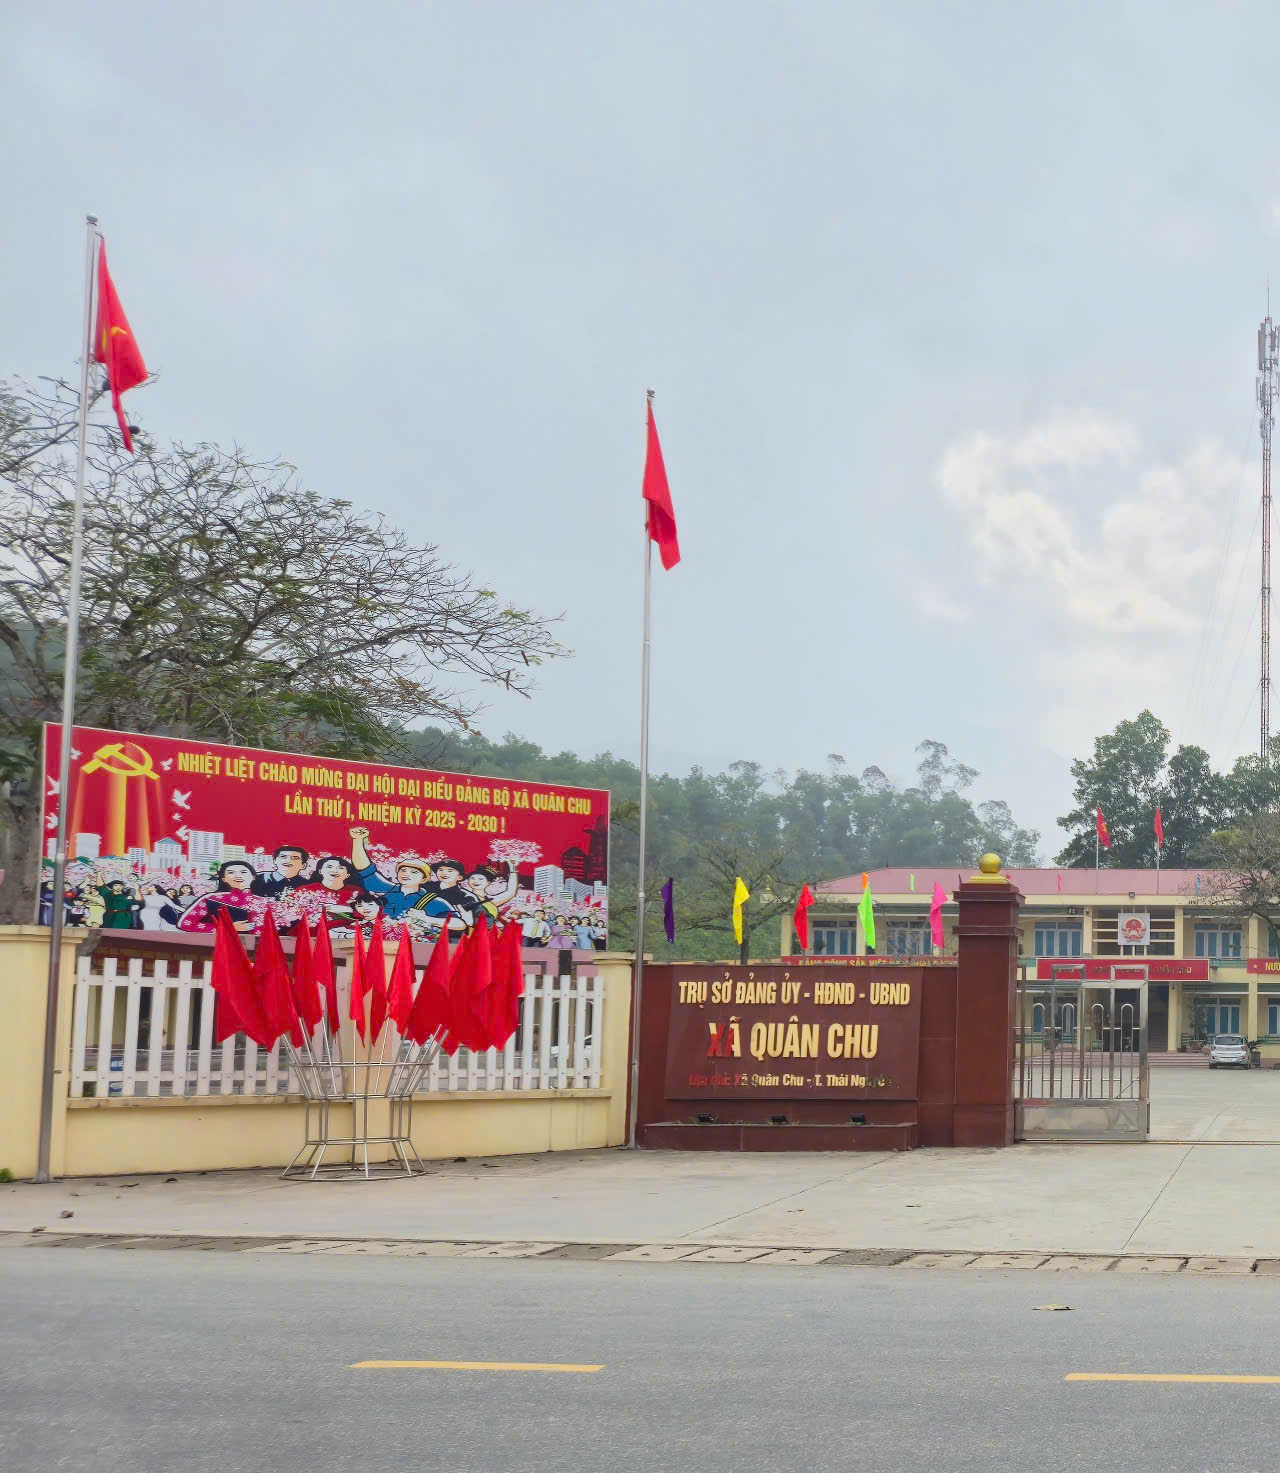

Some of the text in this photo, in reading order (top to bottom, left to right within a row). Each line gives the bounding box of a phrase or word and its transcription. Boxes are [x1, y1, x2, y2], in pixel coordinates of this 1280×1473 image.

[178, 752, 592, 815] NHIỆT LIỆT CHÀO MỪNG ĐẠI HỘI ĐẠI BIỂU ĐẢNG BỘ XÃ QUÂN CHU
[285, 790, 313, 815] LẦN
[316, 795, 344, 818] THỨ
[346, 801, 355, 821] I,
[358, 802, 401, 827] NHIỆM
[405, 804, 421, 826] KỲ
[425, 810, 456, 828] 2025
[468, 814, 498, 833] 2030
[679, 981, 708, 1008] TRỤ
[711, 972, 733, 1004] SỞ
[735, 972, 777, 1004] ĐẢNG
[781, 972, 802, 1004] ỦY
[814, 982, 855, 1005] HĐND
[870, 983, 911, 1005] UBND
[707, 1015, 879, 1061] XÃ QUÂN CHU
[751, 1073, 779, 1087] Quân
[782, 1073, 804, 1086] Chu
[826, 1073, 848, 1087] Thái
